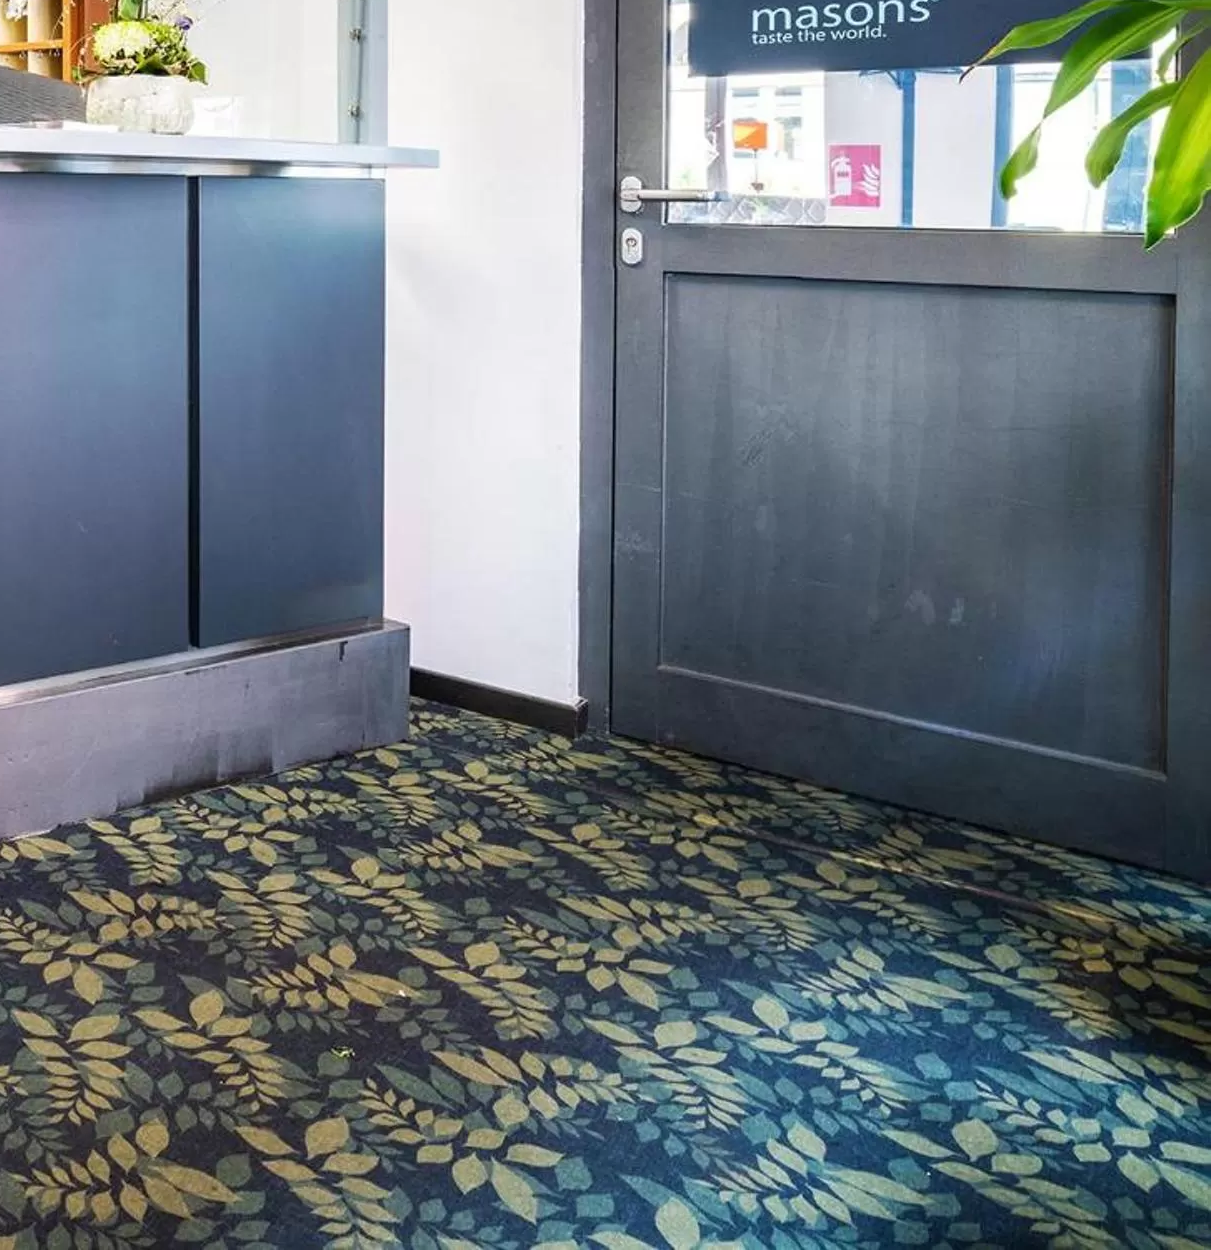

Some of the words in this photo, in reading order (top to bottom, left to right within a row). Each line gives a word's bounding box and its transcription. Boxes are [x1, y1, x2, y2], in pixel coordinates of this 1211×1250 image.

[751, 31, 793, 45] taste
[797, 28, 826, 42] the
[830, 24, 887, 40] world.
